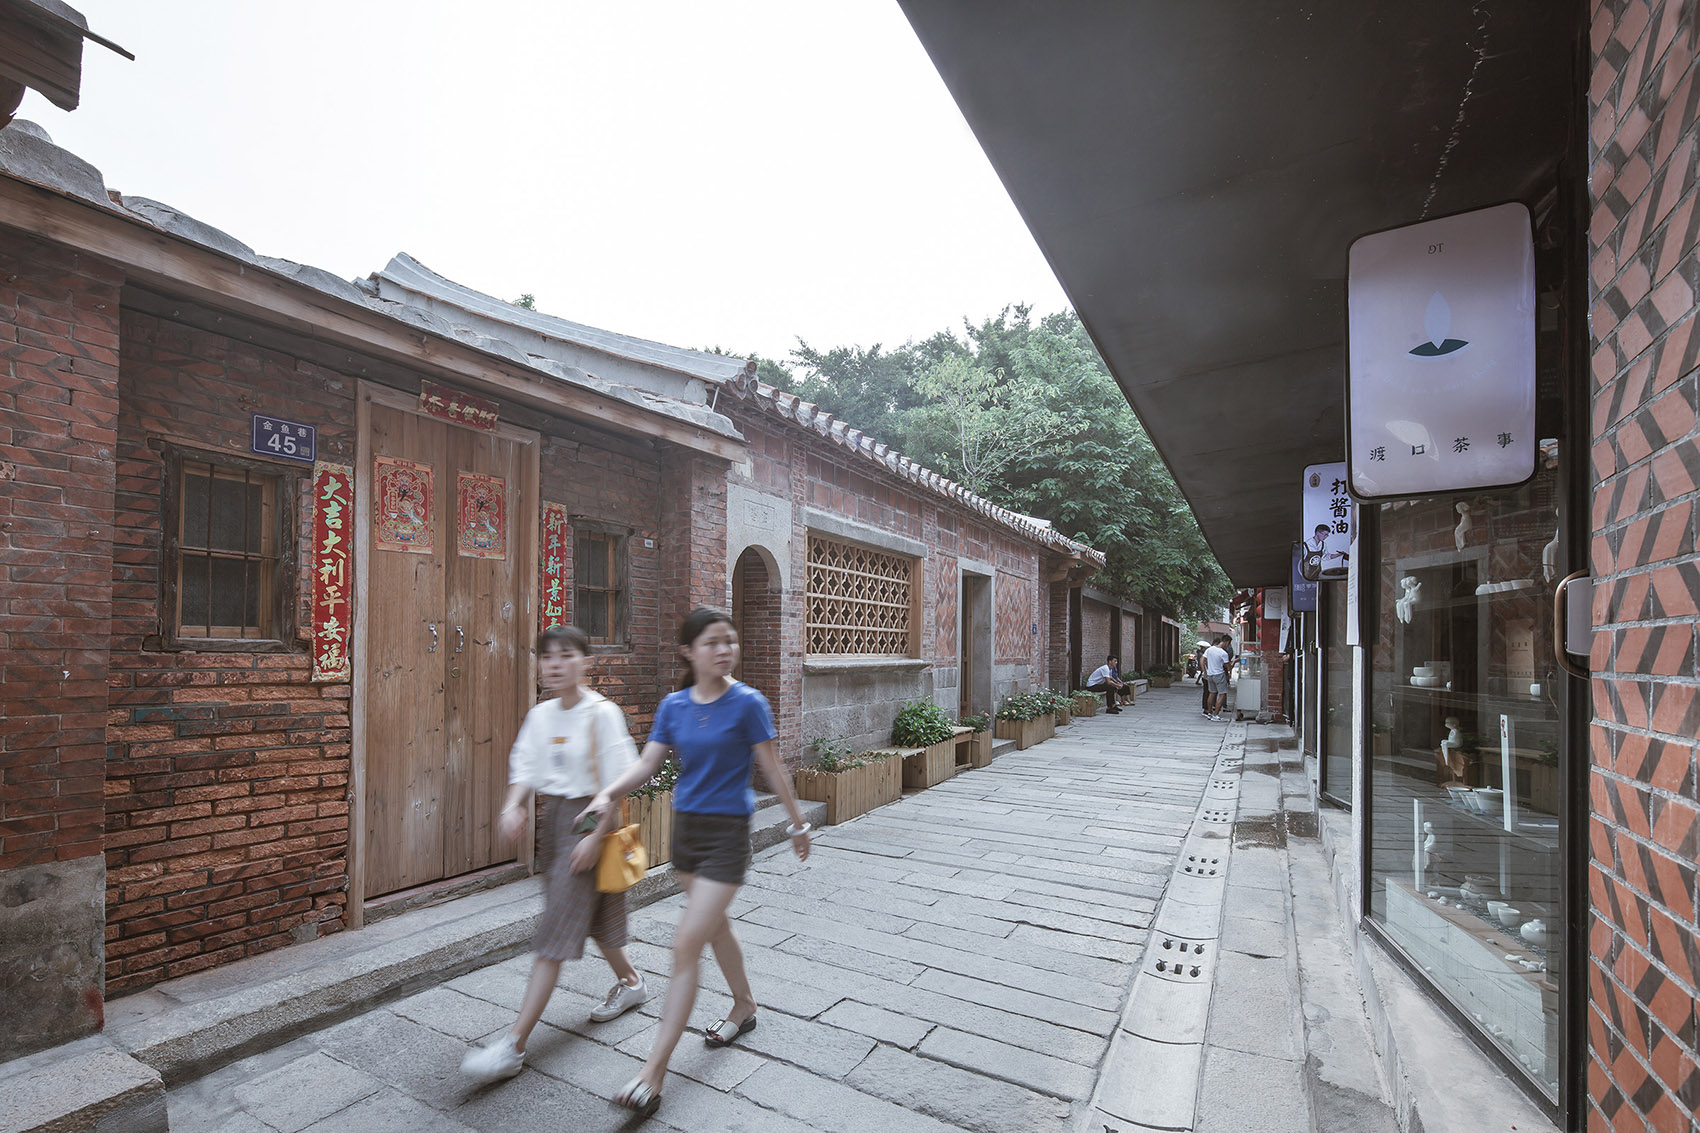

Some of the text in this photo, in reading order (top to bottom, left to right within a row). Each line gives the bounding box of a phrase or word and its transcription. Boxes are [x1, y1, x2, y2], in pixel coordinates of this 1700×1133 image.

[267, 433, 297, 455] 45
[1369, 432, 1514, 462] 渡口茶事
[1329, 478, 1352, 535] 打酱油
[317, 476, 348, 671] 大吉大利平安福
